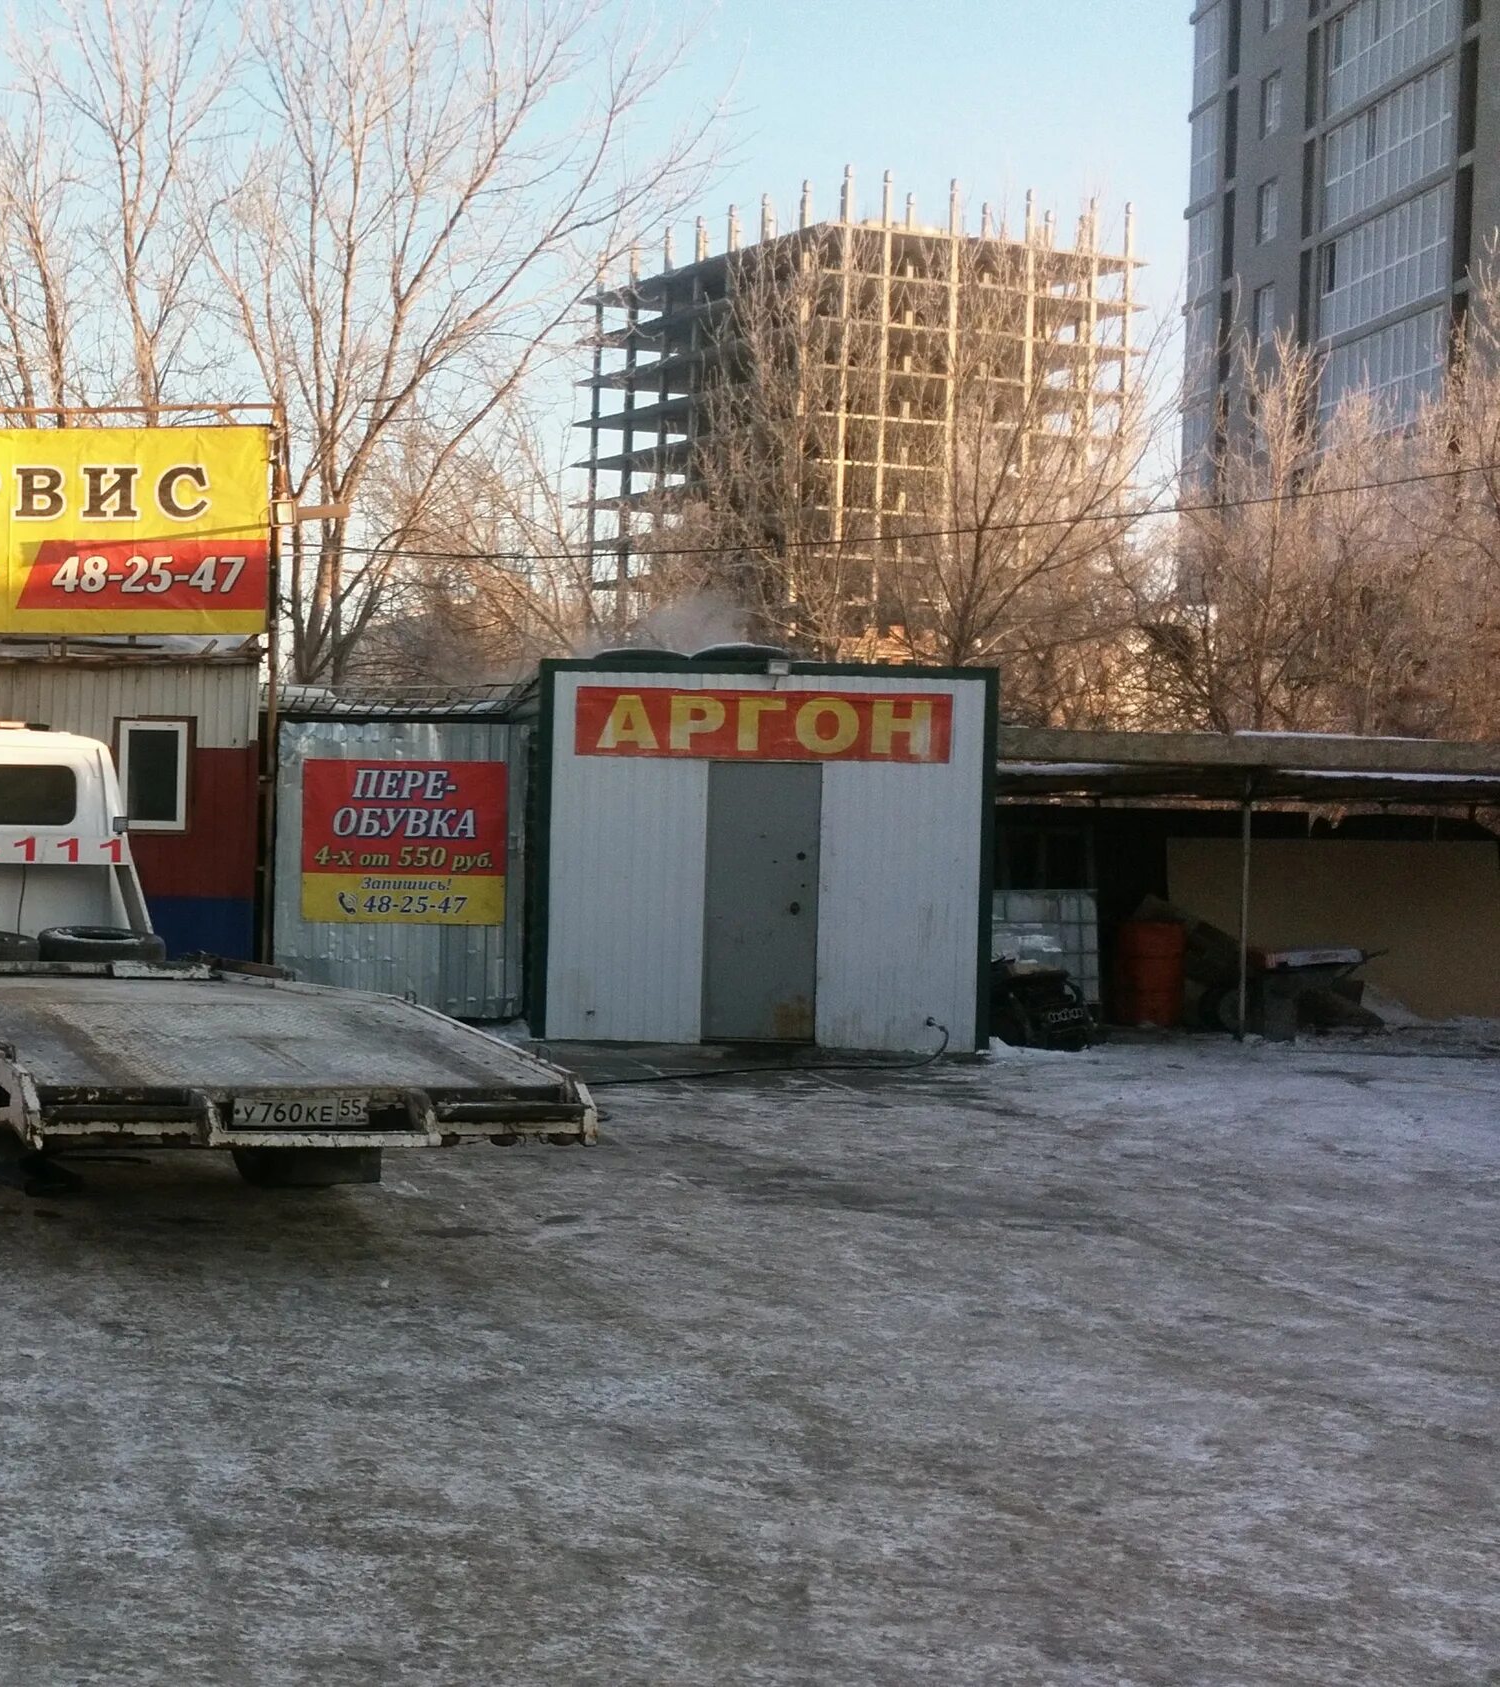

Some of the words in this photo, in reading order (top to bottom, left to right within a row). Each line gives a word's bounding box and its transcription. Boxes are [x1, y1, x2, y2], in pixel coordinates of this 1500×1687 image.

[51, 555, 246, 594] 48-25-47
[596, 695, 932, 757] АРГОН
[352, 769, 457, 800] ПЕРЕ-
[332, 806, 476, 839] ОБУВКА
[359, 853, 390, 867] от
[397, 847, 447, 867] 550
[451, 852, 493, 871] руб.
[361, 876, 452, 892] Запишись!
[363, 896, 468, 915] 48-25-47
